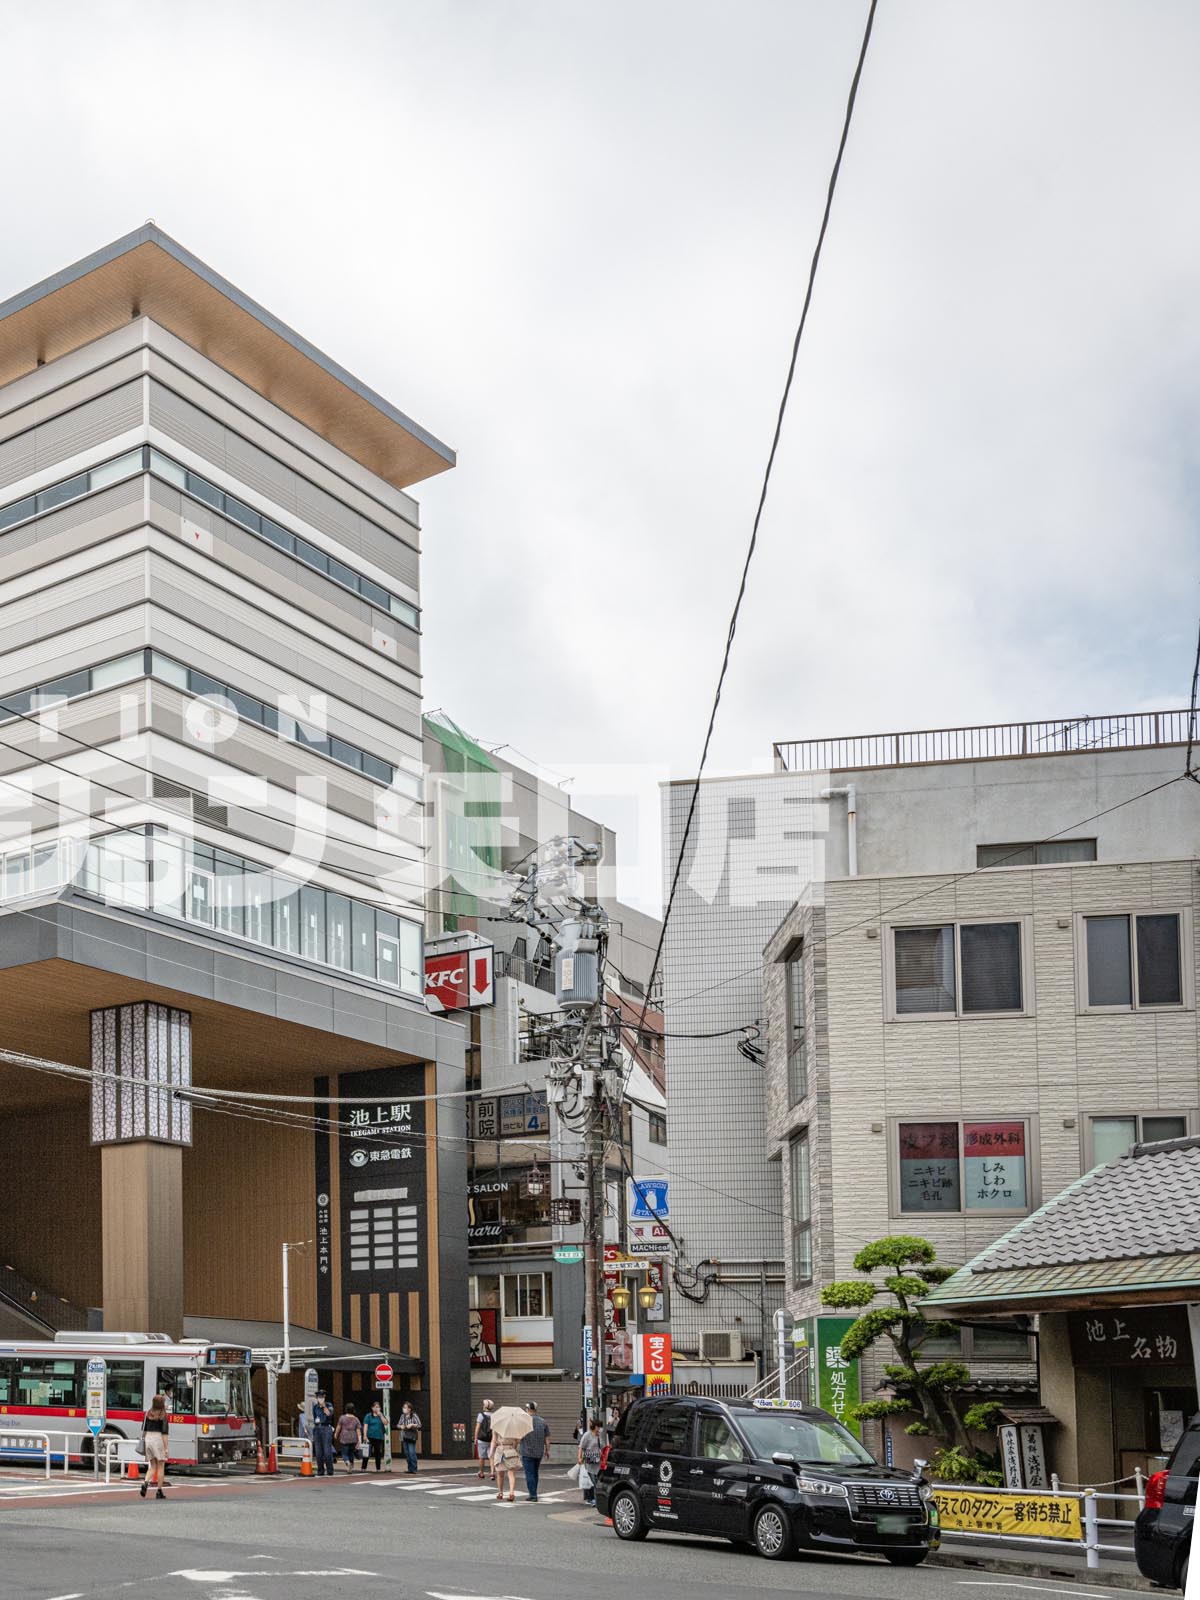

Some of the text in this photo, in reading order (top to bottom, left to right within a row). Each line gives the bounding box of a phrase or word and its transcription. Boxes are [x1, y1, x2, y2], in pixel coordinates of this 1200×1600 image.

[425, 968, 465, 988] KFC
[349, 1104, 412, 1126] 池上駅
[478, 1102, 495, 1136] 前院
[350, 1124, 411, 1137] IKEGAMI STATION
[966, 1131, 1021, 1146] 形成外科
[369, 1148, 412, 1161] 東急電鉄
[913, 1166, 946, 1176] ニキビ
[982, 1162, 1005, 1173] しみ
[633, 1182, 667, 1191] AWSON
[983, 1175, 1005, 1186] しわ
[474, 1182, 508, 1193] SALON
[978, 1189, 1012, 1199] ホクロ
[1086, 1319, 1177, 1359] 池上 名物
[649, 1337, 664, 1372] 宝くじ
